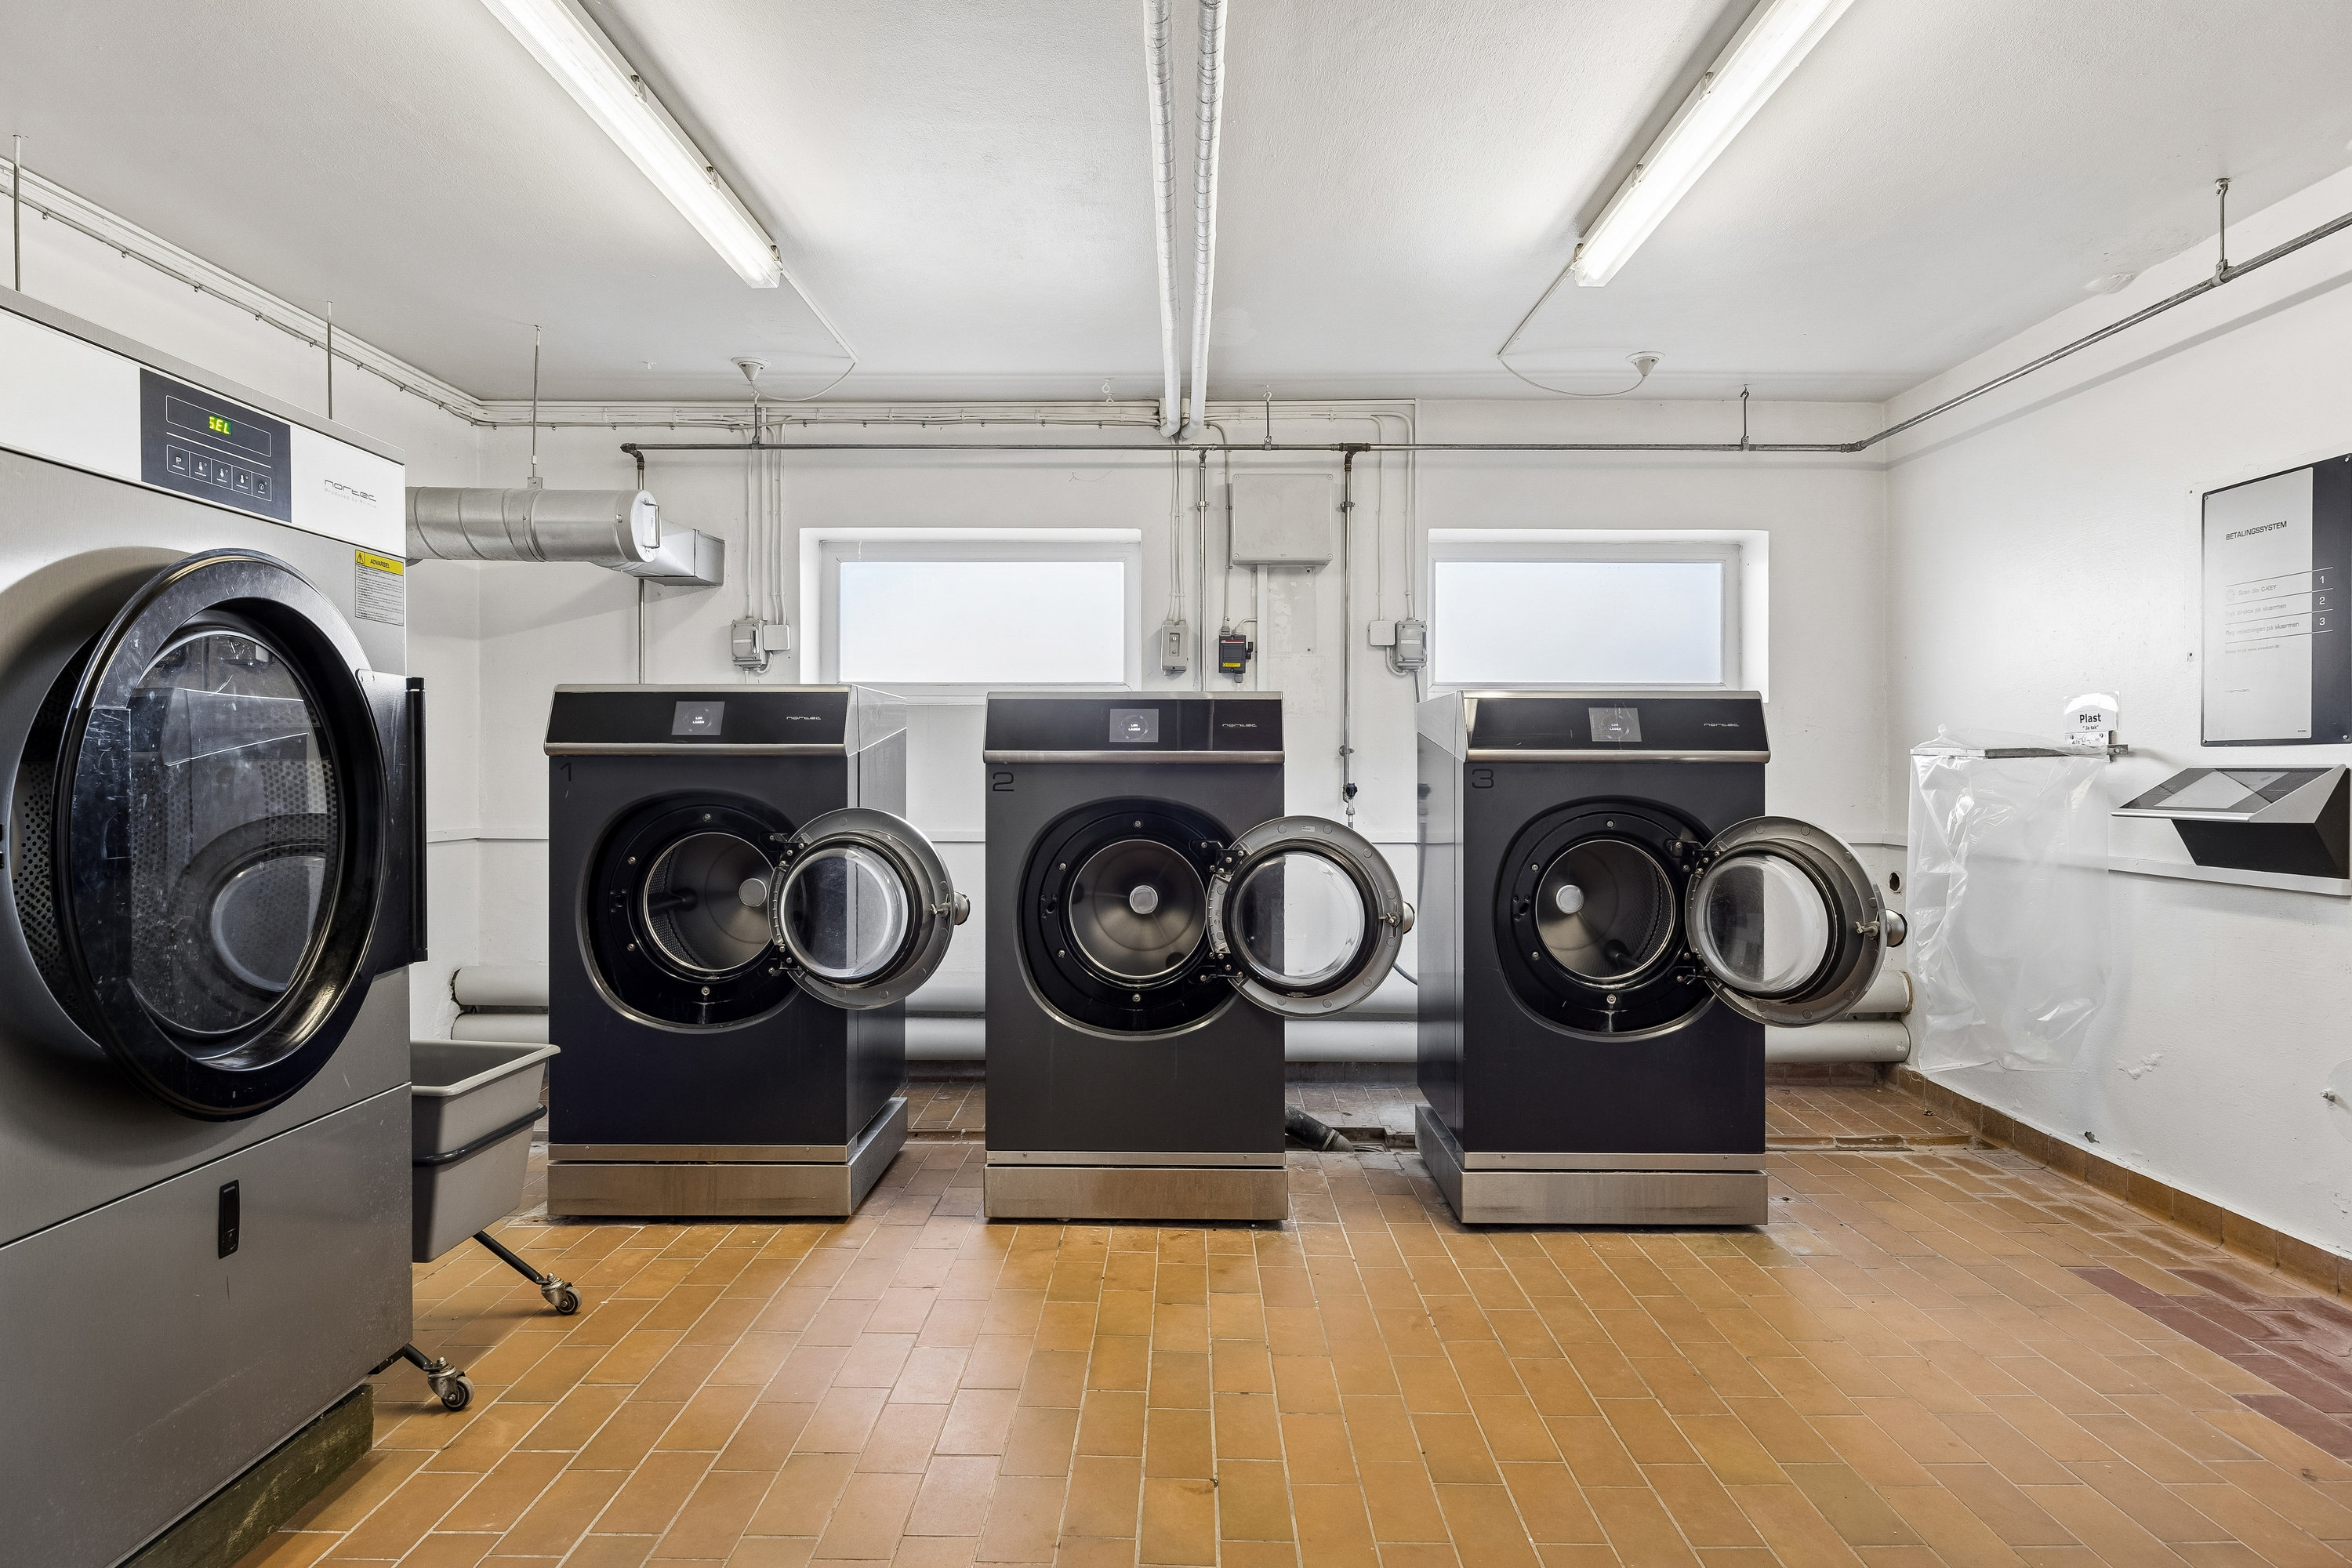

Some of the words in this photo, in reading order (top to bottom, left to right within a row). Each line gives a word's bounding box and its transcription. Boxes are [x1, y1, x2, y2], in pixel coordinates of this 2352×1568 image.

[209, 416, 230, 435] SEL
[324, 479, 376, 502] nortec
[2225, 521, 2288, 541] BETALINGSSYSTEM
[370, 558, 390, 569] ADVARSEL
[2319, 575, 2325, 584] 1
[2260, 584, 2278, 593] C-KEY
[2319, 596, 2326, 605] 2
[2262, 603, 2287, 612] skærmen
[2274, 622, 2299, 630] skærmen
[2319, 617, 2326, 626] 3
[2079, 713, 2102, 724] Plast
[560, 762, 572, 782] 1
[993, 771, 1014, 792] 2
[1472, 768, 1494, 789] 3
